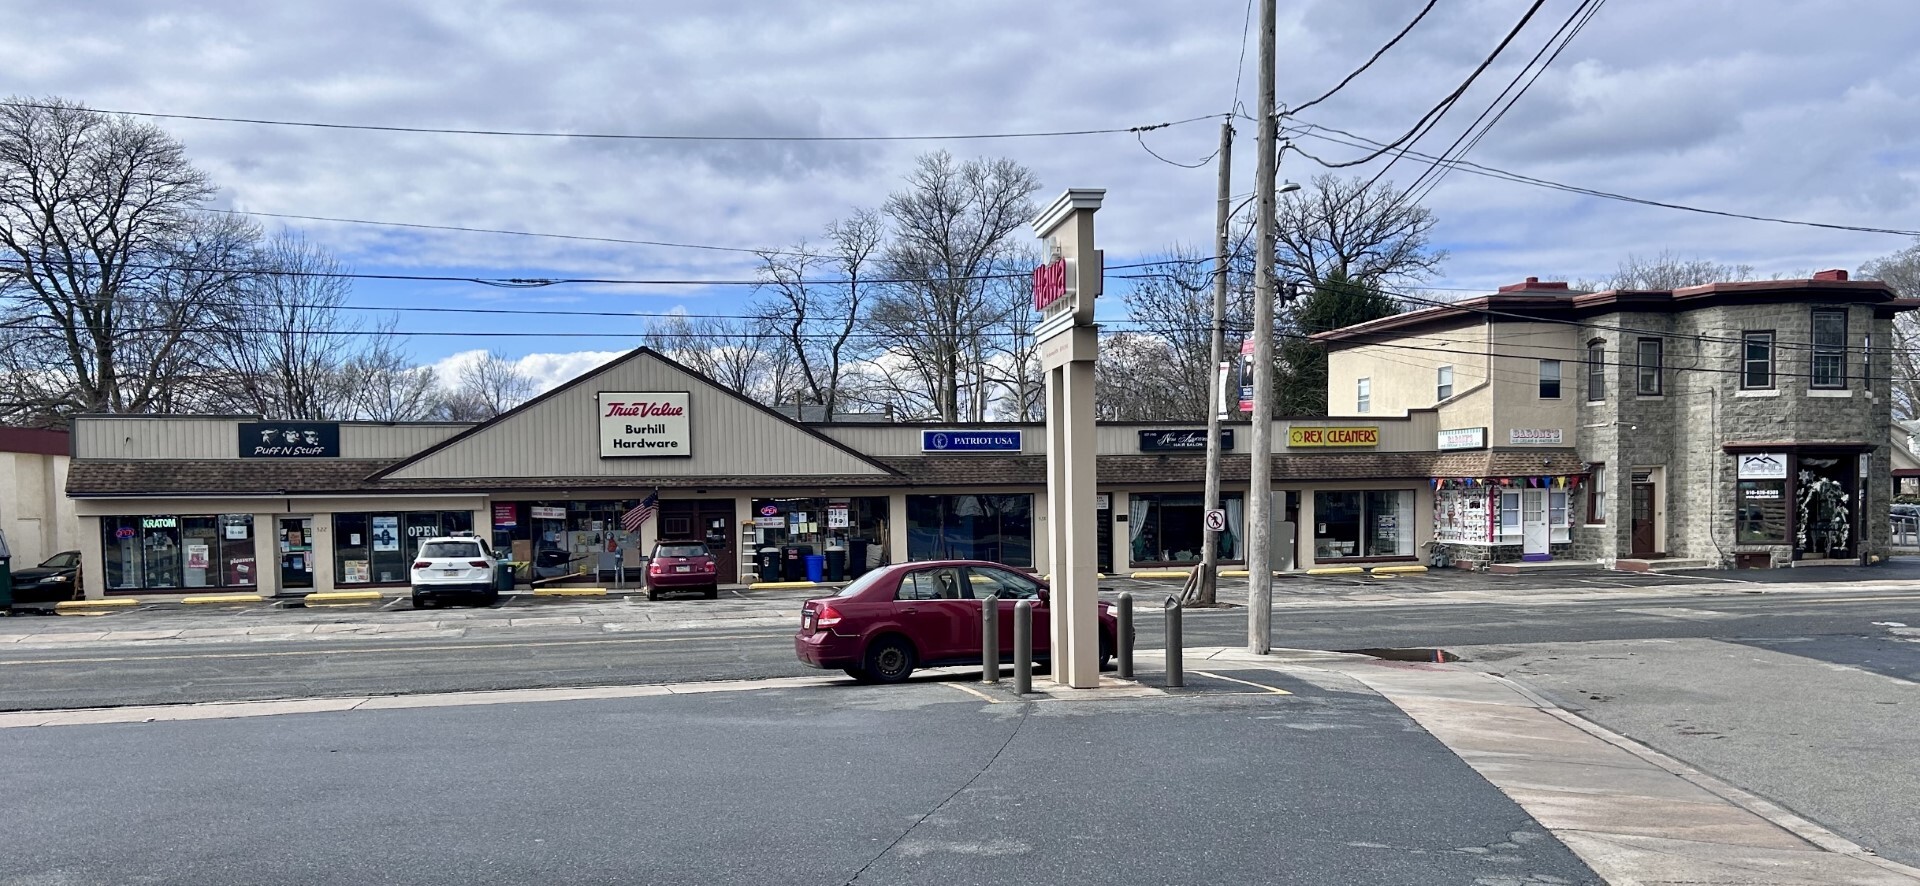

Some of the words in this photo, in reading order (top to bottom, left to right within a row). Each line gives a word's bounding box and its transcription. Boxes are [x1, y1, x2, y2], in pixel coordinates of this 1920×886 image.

[1034, 257, 1067, 312] Wawa
[625, 424, 666, 434] Burhill
[954, 437, 992, 445] PATRIOT
[995, 437, 1013, 445] USA
[1304, 430, 1323, 443] REX
[1327, 430, 1377, 443] CLEANERS
[613, 438, 679, 448] Hardware
[254, 446, 281, 455] Puff
[281, 446, 293, 455] N
[293, 446, 325, 456] Stuff
[761, 506, 778, 515] OPEN
[143, 519, 177, 528] KRATOM
[116, 529, 135, 538] OPEN
[408, 525, 439, 537] OPEN
